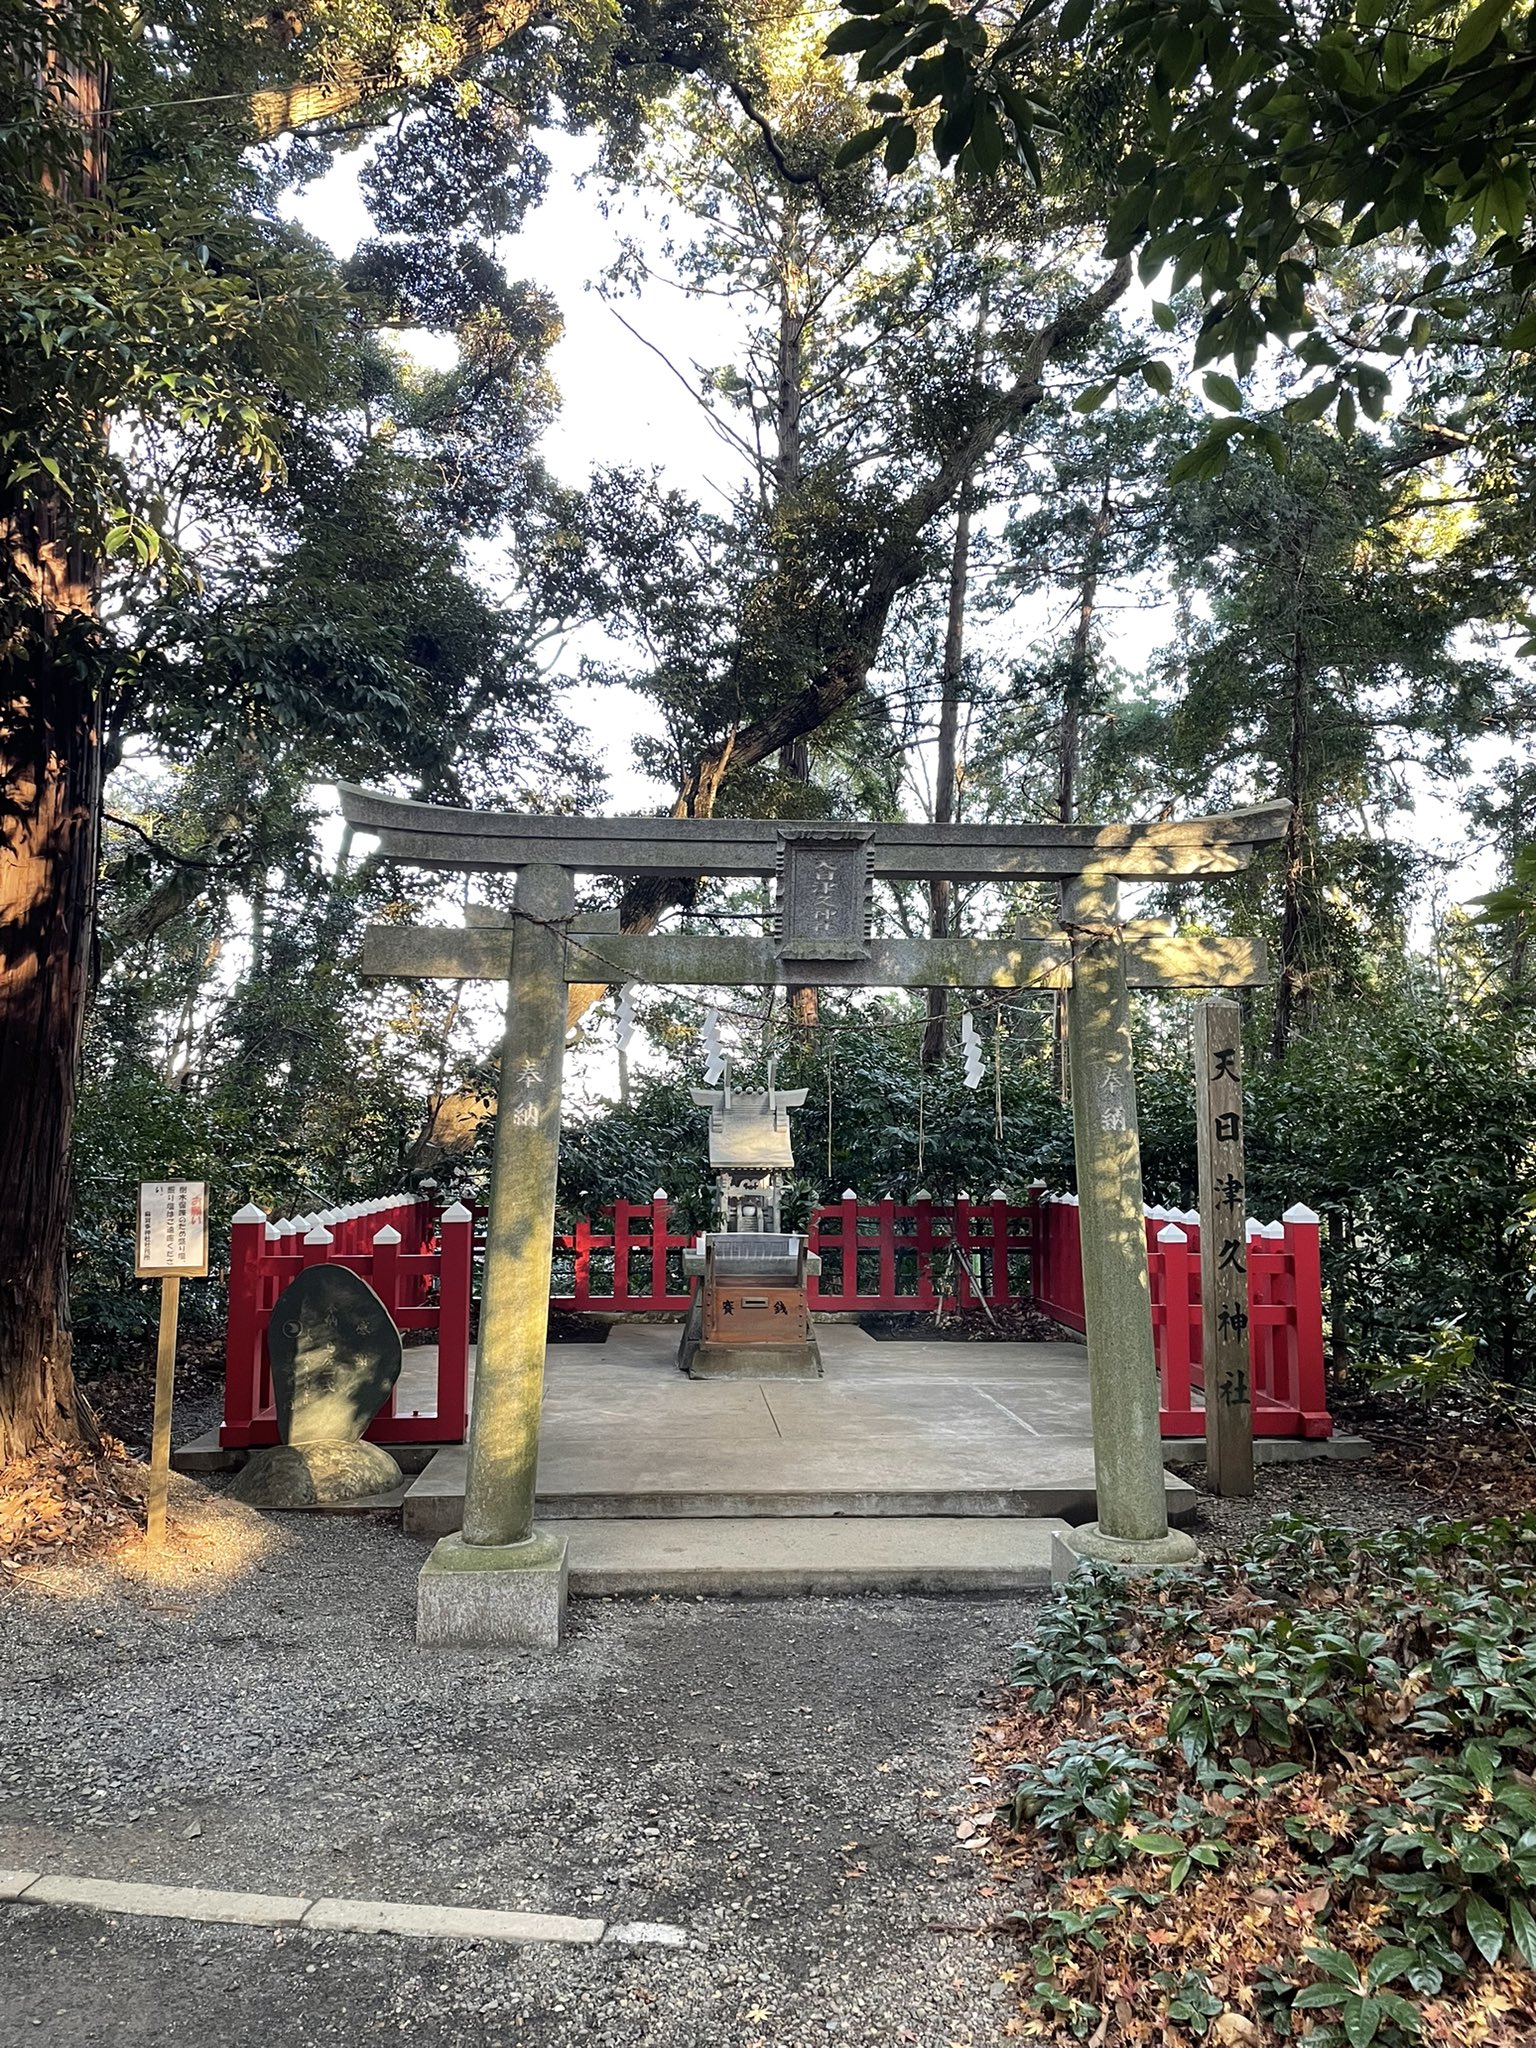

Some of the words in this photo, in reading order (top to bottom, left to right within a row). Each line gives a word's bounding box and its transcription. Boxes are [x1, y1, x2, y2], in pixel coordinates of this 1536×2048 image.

[513, 1059, 544, 1127] 奉納
[1100, 1065, 1127, 1131] 奉納
[1211, 1048, 1251, 1408] 天日津久神社
